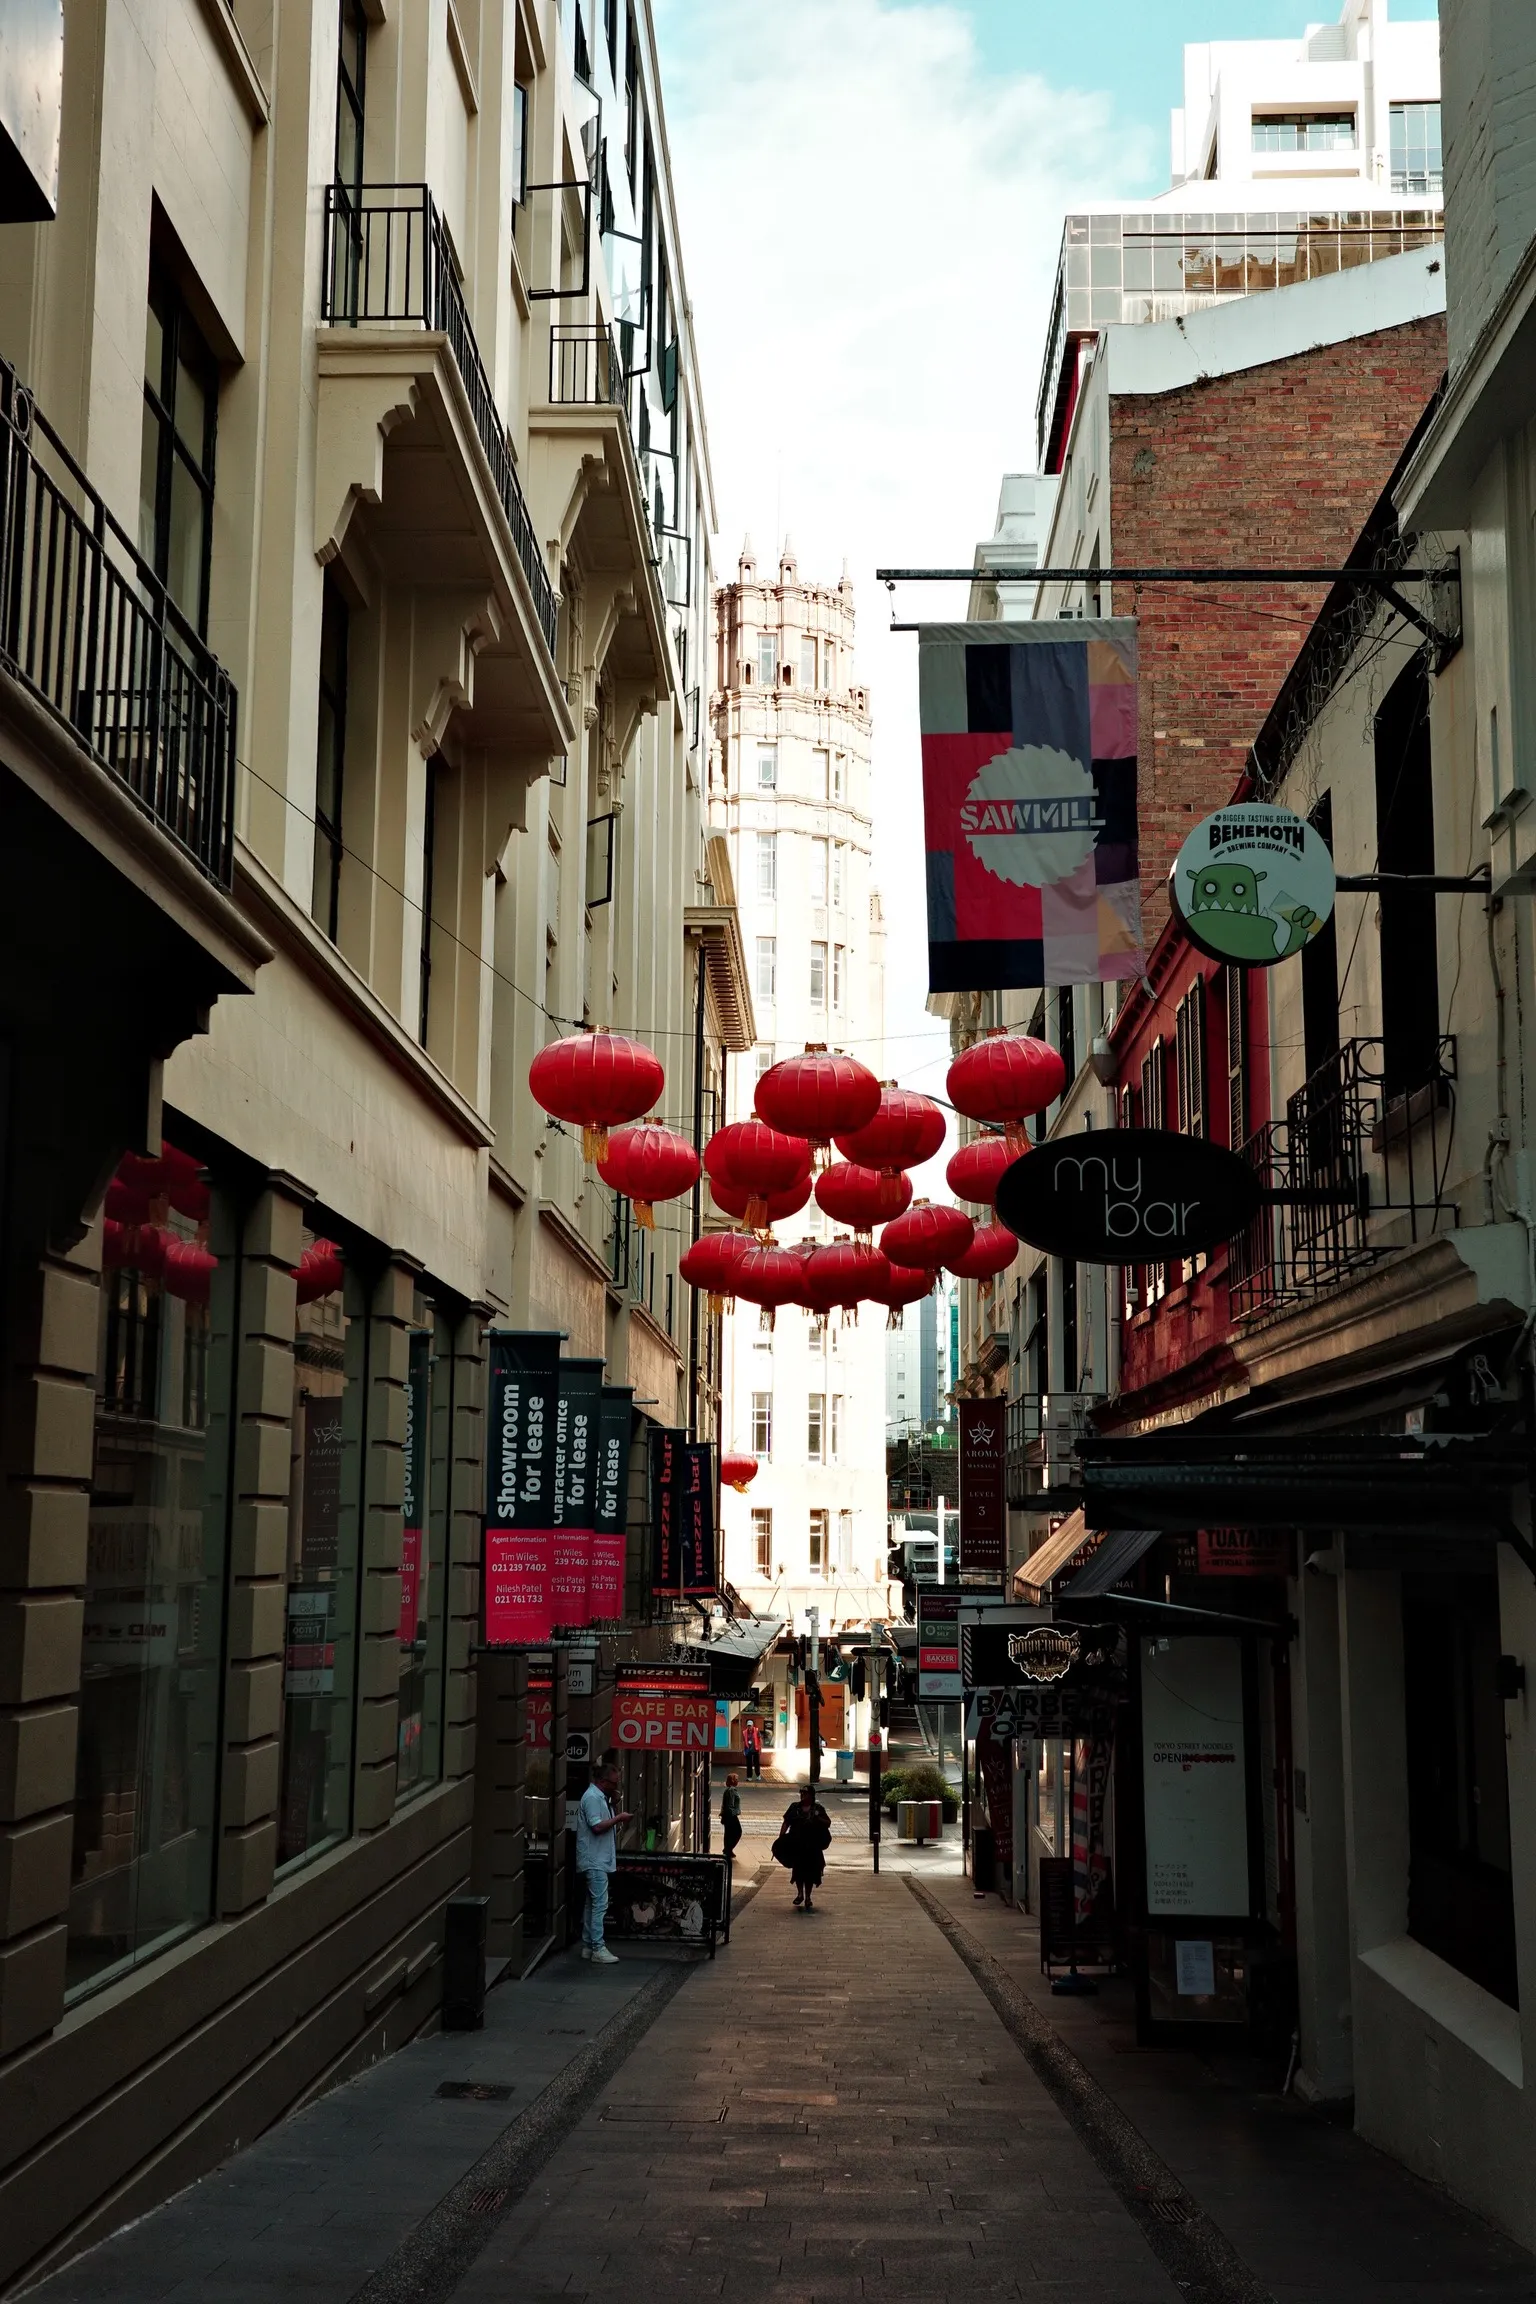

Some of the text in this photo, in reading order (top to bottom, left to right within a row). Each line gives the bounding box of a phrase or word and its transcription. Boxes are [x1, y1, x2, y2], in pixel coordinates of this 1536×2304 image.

[960, 801, 1106, 831] SAWMILL
[1222, 814, 1245, 822] BIGGER
[1248, 815, 1273, 823] TASTING
[1209, 824, 1305, 854] BEHEMOTH
[1227, 842, 1289, 854] BREWING COMPANY
[1054, 1157, 1142, 1203] my
[1105, 1193, 1200, 1237] bar
[497, 1384, 520, 1519] Showroom
[520, 1396, 544, 1502] for lease
[965, 1450, 999, 1458] AROMA
[567, 1414, 588, 1506] for lease
[601, 1438, 620, 1518] for lease
[660, 1433, 673, 1580] mezze bar
[978, 1505, 986, 1516] 3
[690, 1455, 703, 1577] mezze bar
[492, 1536, 509, 1544] Agent
[500, 1552, 539, 1561] Tim Wiles
[562, 1549, 583, 1557] Wiles
[492, 1563, 547, 1572] 021 239 7402
[566, 1576, 585, 1584] Patel
[496, 1584, 520, 1593] Nilesh
[521, 1583, 542, 1593] Patel
[556, 1585, 570, 1593] 761
[572, 1585, 586, 1593] 733
[494, 1595, 510, 1604] 021
[512, 1595, 525, 1603] 761
[527, 1594, 543, 1603] 733
[621, 1667, 707, 1677] mezze bar
[620, 1701, 708, 1718] CAFE BAR
[618, 1719, 709, 1746] OPEN
